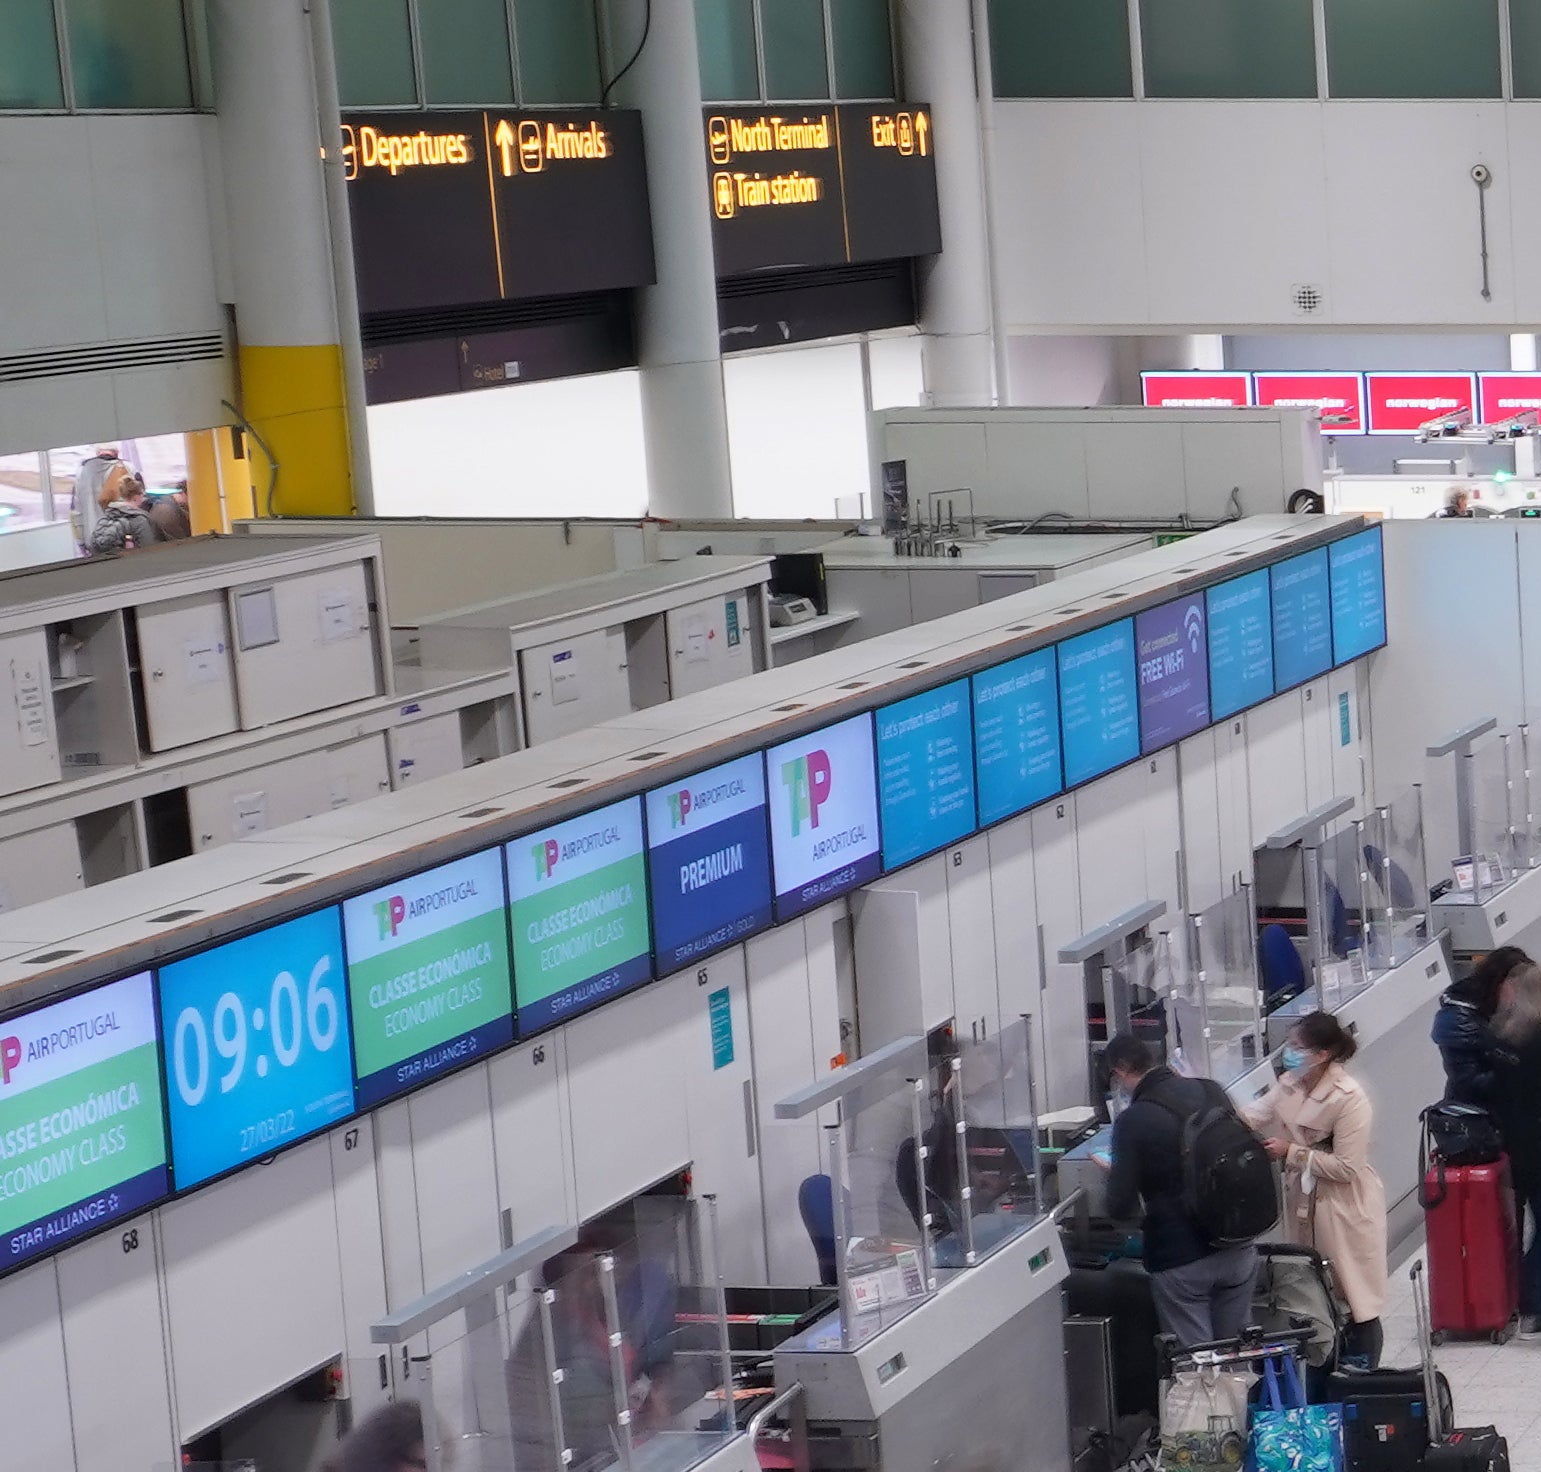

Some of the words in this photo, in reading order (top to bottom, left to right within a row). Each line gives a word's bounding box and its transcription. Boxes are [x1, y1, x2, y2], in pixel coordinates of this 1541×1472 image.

[360, 126, 467, 176] Departures
[546, 121, 606, 159] Arrivals
[730, 117, 771, 152] North
[771, 115, 829, 150] Terminal
[872, 116, 896, 147] Exit
[734, 173, 769, 207] Train
[772, 171, 818, 205] station
[1386, 397, 1458, 410] norwegian
[1411, 486, 1425, 494] 121
[1141, 658, 1164, 685] FREE
[667, 790, 691, 829] TAP
[781, 749, 831, 838] TAP
[531, 839, 559, 881] TAP
[680, 844, 743, 894] PREMIUM
[802, 883, 820, 902] STAR
[820, 870, 848, 893] ALLIANCE
[373, 895, 405, 940] TAP
[527, 907, 570, 944] CLASSE
[570, 884, 633, 928] ECONÓMICA
[541, 931, 593, 971] ECONOMY
[594, 918, 624, 948] CLASS
[675, 945, 694, 961] STAR
[693, 927, 726, 953] ALLIANCE
[368, 969, 418, 1009] CLASSE
[419, 941, 492, 990] ECONÓMICA
[385, 996, 447, 1038] ECONOMY
[448, 977, 482, 1010] CLASS
[551, 994, 573, 1014] STAR
[574, 977, 613, 1007] ALLIANCE
[174, 954, 338, 1107] 09:06
[396, 1060, 424, 1082] STAR
[423, 1039, 467, 1073] ALLIANCE
[533, 1045, 544, 1065] 66
[40, 1082, 140, 1145] ECONÓMICA
[239, 1109, 295, 1152] 27/03/22
[78, 1125, 127, 1165] CLASS
[345, 1128, 358, 1151] 67
[10, 1226, 45, 1254] STAR
[45, 1198, 105, 1242] ALLIANCE
[122, 1229, 138, 1253] 68
